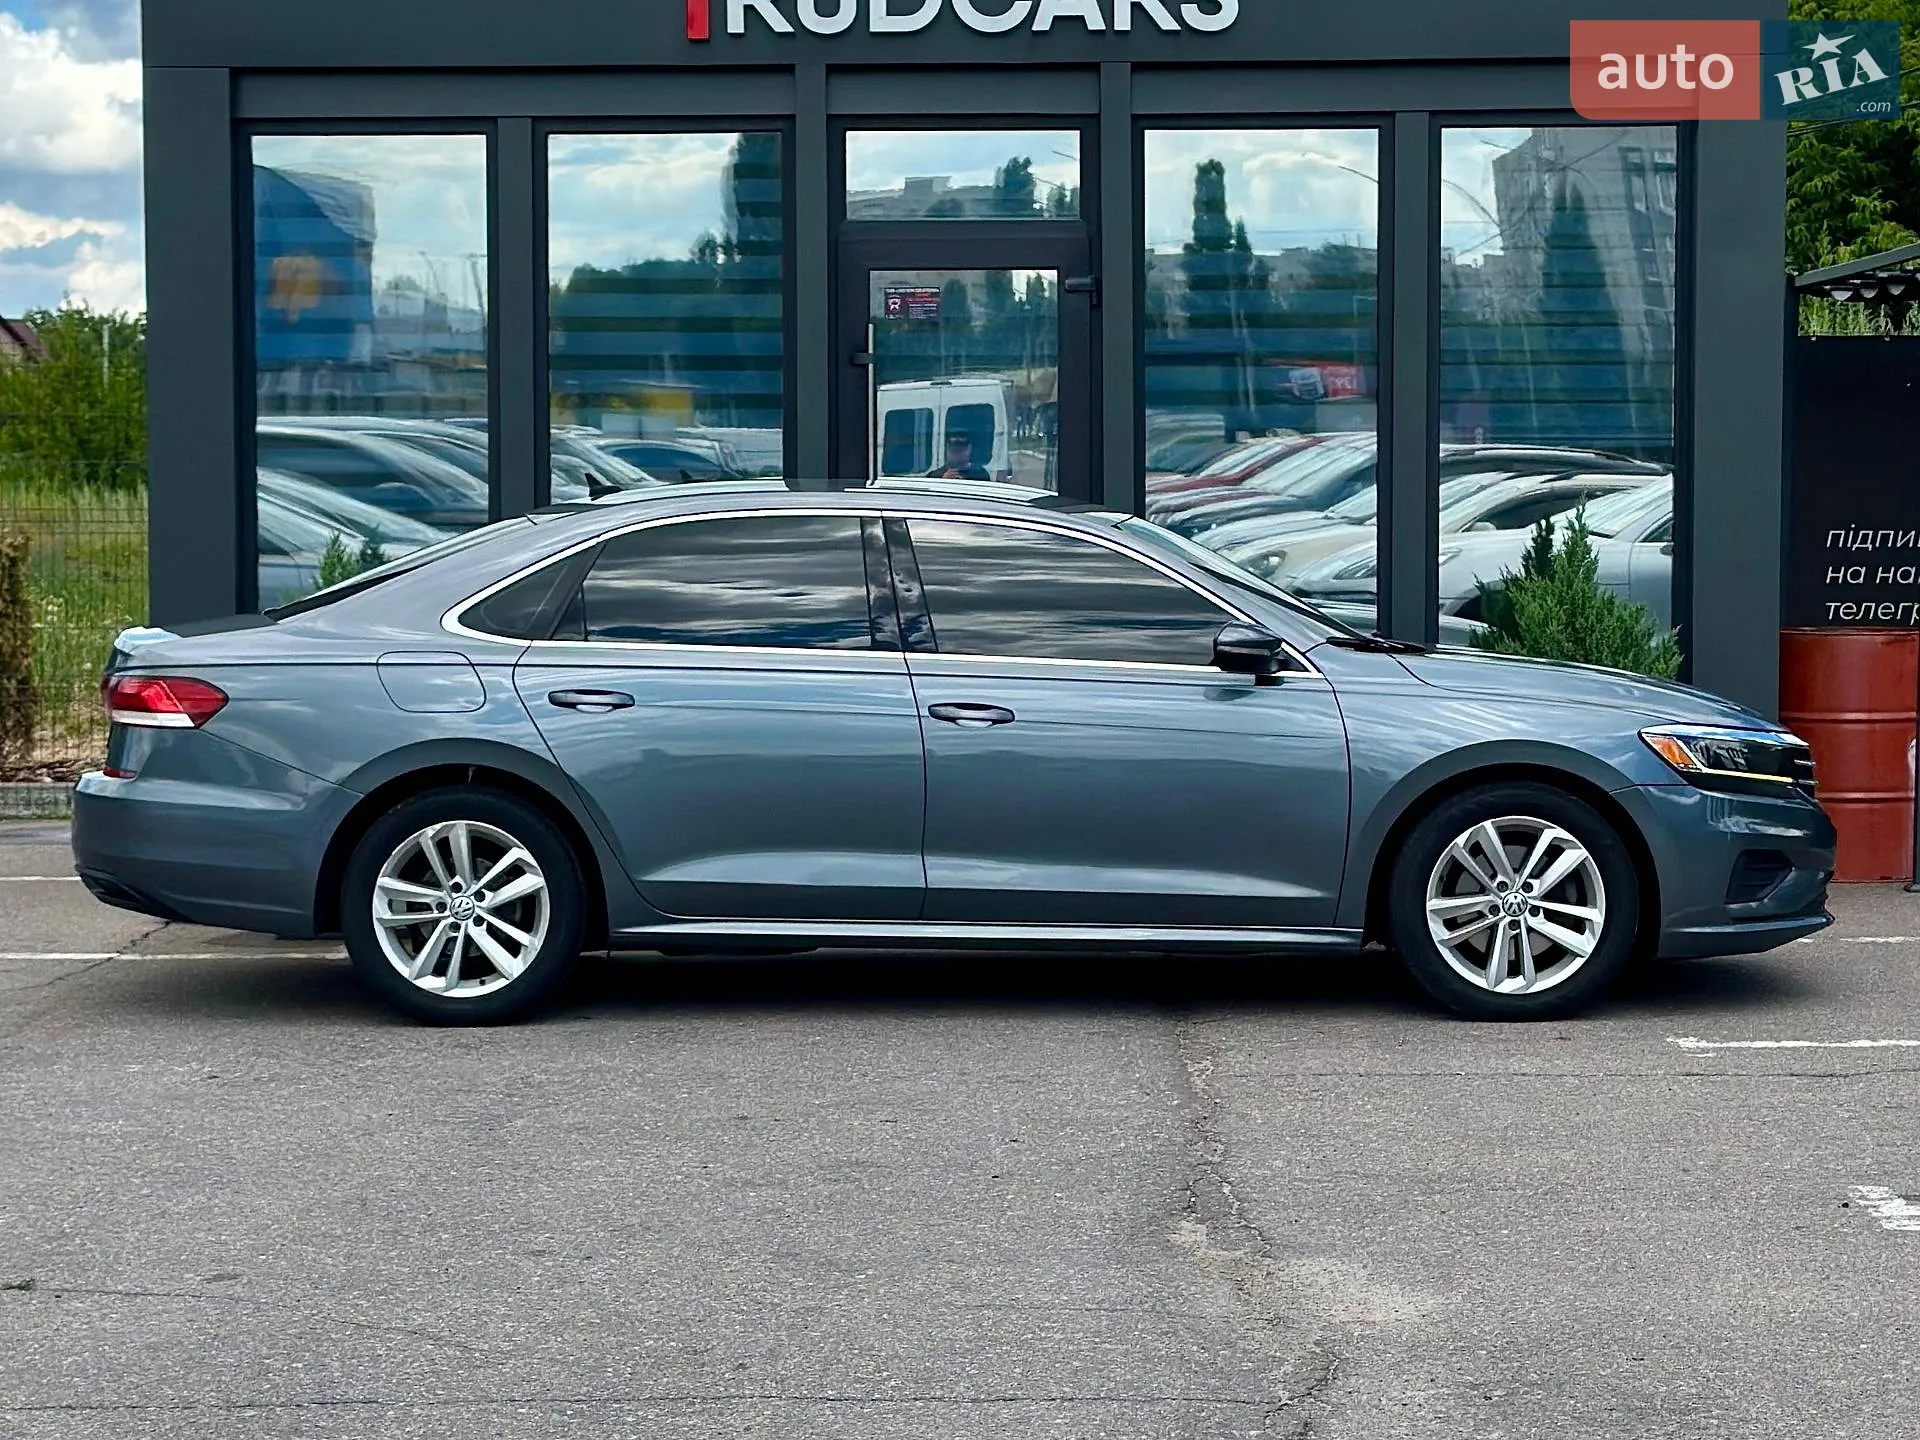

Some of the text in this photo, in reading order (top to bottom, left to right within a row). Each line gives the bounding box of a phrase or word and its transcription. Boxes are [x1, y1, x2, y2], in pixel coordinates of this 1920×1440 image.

[1826, 523, 1920, 552] підпи
[1825, 566, 1920, 584] на на
